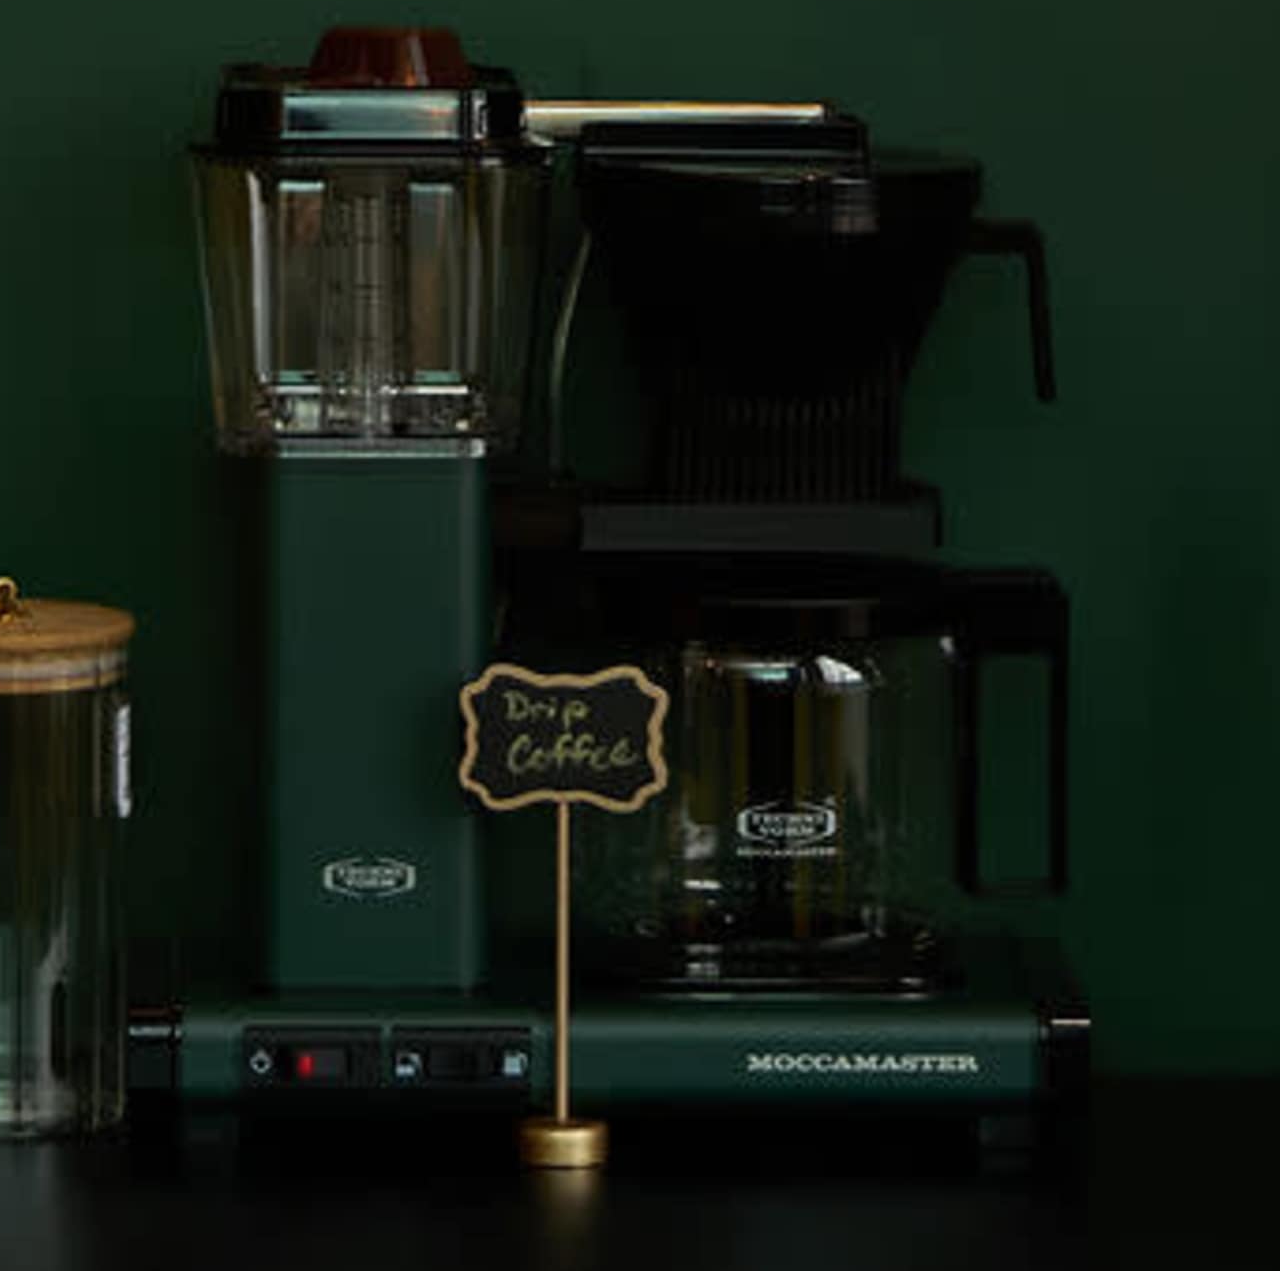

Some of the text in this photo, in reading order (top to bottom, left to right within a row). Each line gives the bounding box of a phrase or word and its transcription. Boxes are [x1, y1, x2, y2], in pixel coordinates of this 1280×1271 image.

[502, 688, 591, 730] Drip
[506, 732, 638, 775] Coffee
[746, 1052, 980, 1074] MOCCAMASTER
